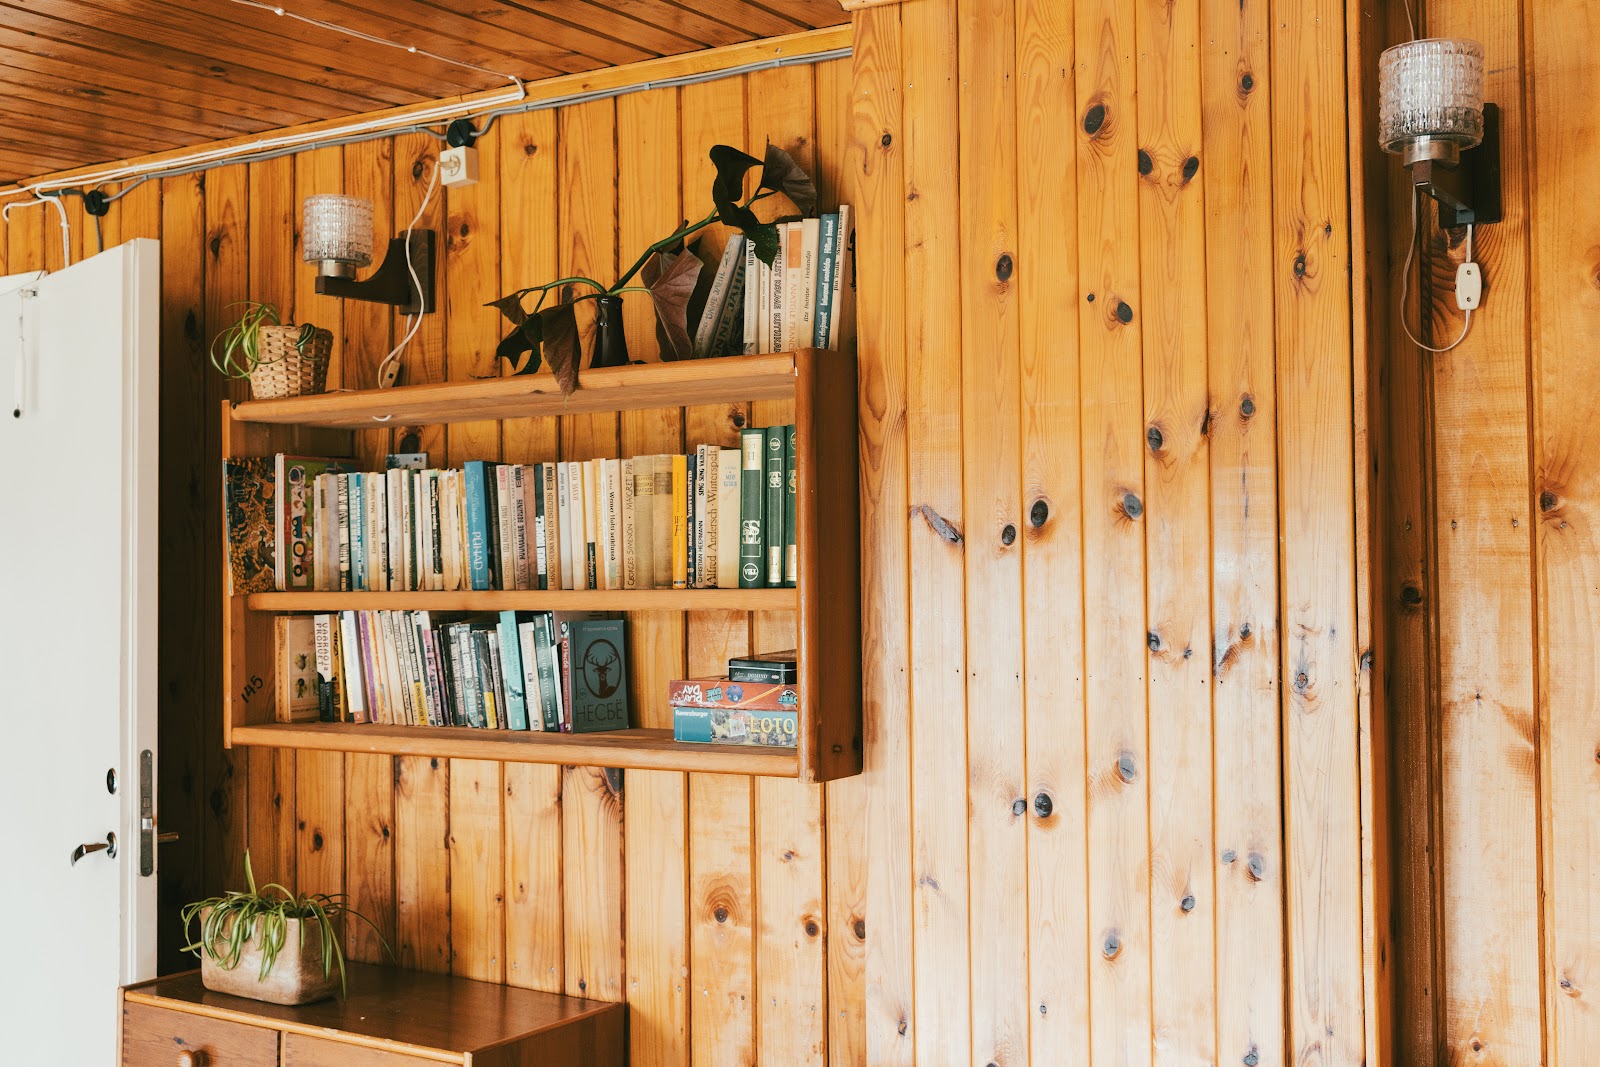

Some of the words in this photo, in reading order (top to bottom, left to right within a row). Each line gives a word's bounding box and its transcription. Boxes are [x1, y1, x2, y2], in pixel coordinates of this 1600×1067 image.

[789, 283, 797, 318] ANATOLE
[788, 321, 797, 353] FRANCE
[707, 450, 719, 502] Winterspelt
[707, 508, 717, 552] Andersch
[472, 531, 483, 570] PÜHAD
[707, 555, 717, 586] Alfred
[316, 622, 324, 666] PROHVET
[683, 684, 701, 695] DAY
[683, 691, 703, 703] PLAY
[576, 699, 623, 723] НЕСБЁ
[675, 709, 709, 718] Ravensburger
[750, 717, 795, 734] LOTO
